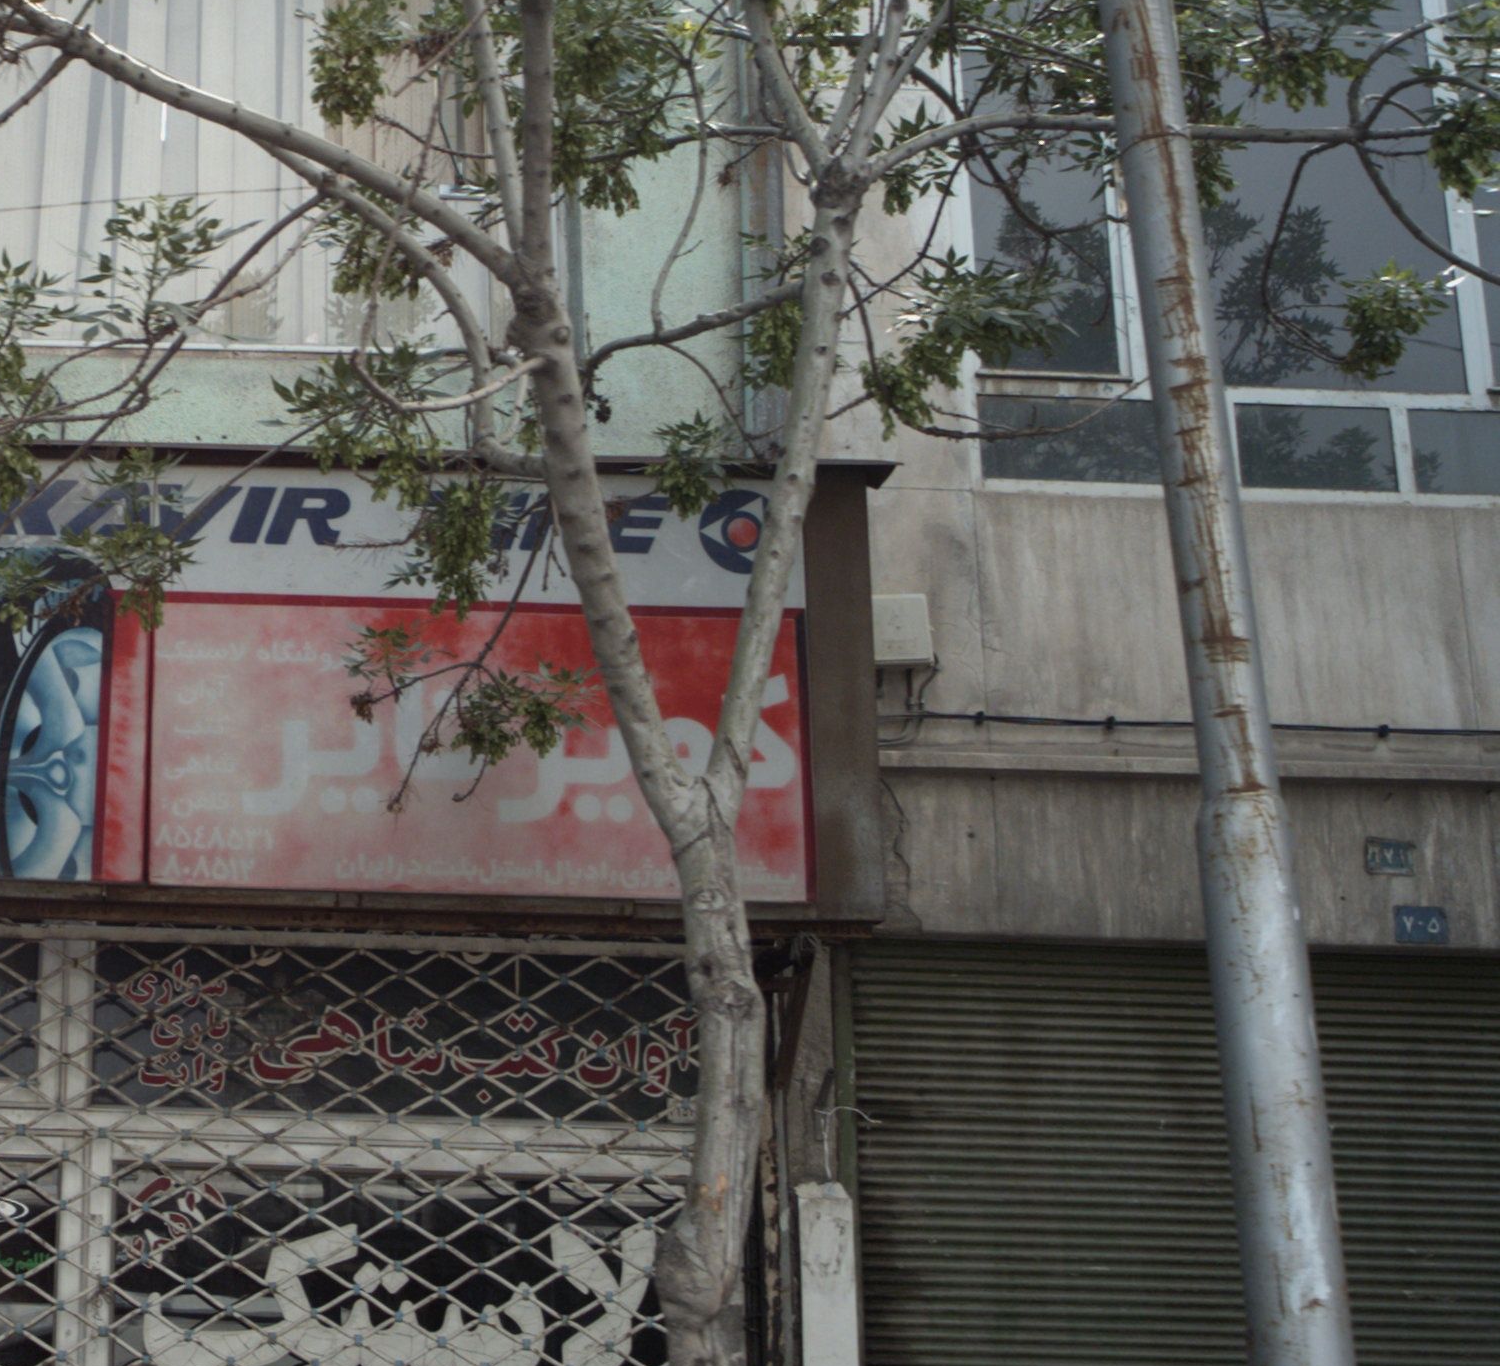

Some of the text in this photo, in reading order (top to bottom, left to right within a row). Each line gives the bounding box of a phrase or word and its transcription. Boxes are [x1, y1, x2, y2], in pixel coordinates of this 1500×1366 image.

[156, 640, 364, 672] روشگاه لاستیک
[124, 958, 228, 1008] سواری
[249, 1004, 446, 1085] شاهی
[575, 1015, 700, 1098] آوان
[138, 1051, 227, 1095] وانت
